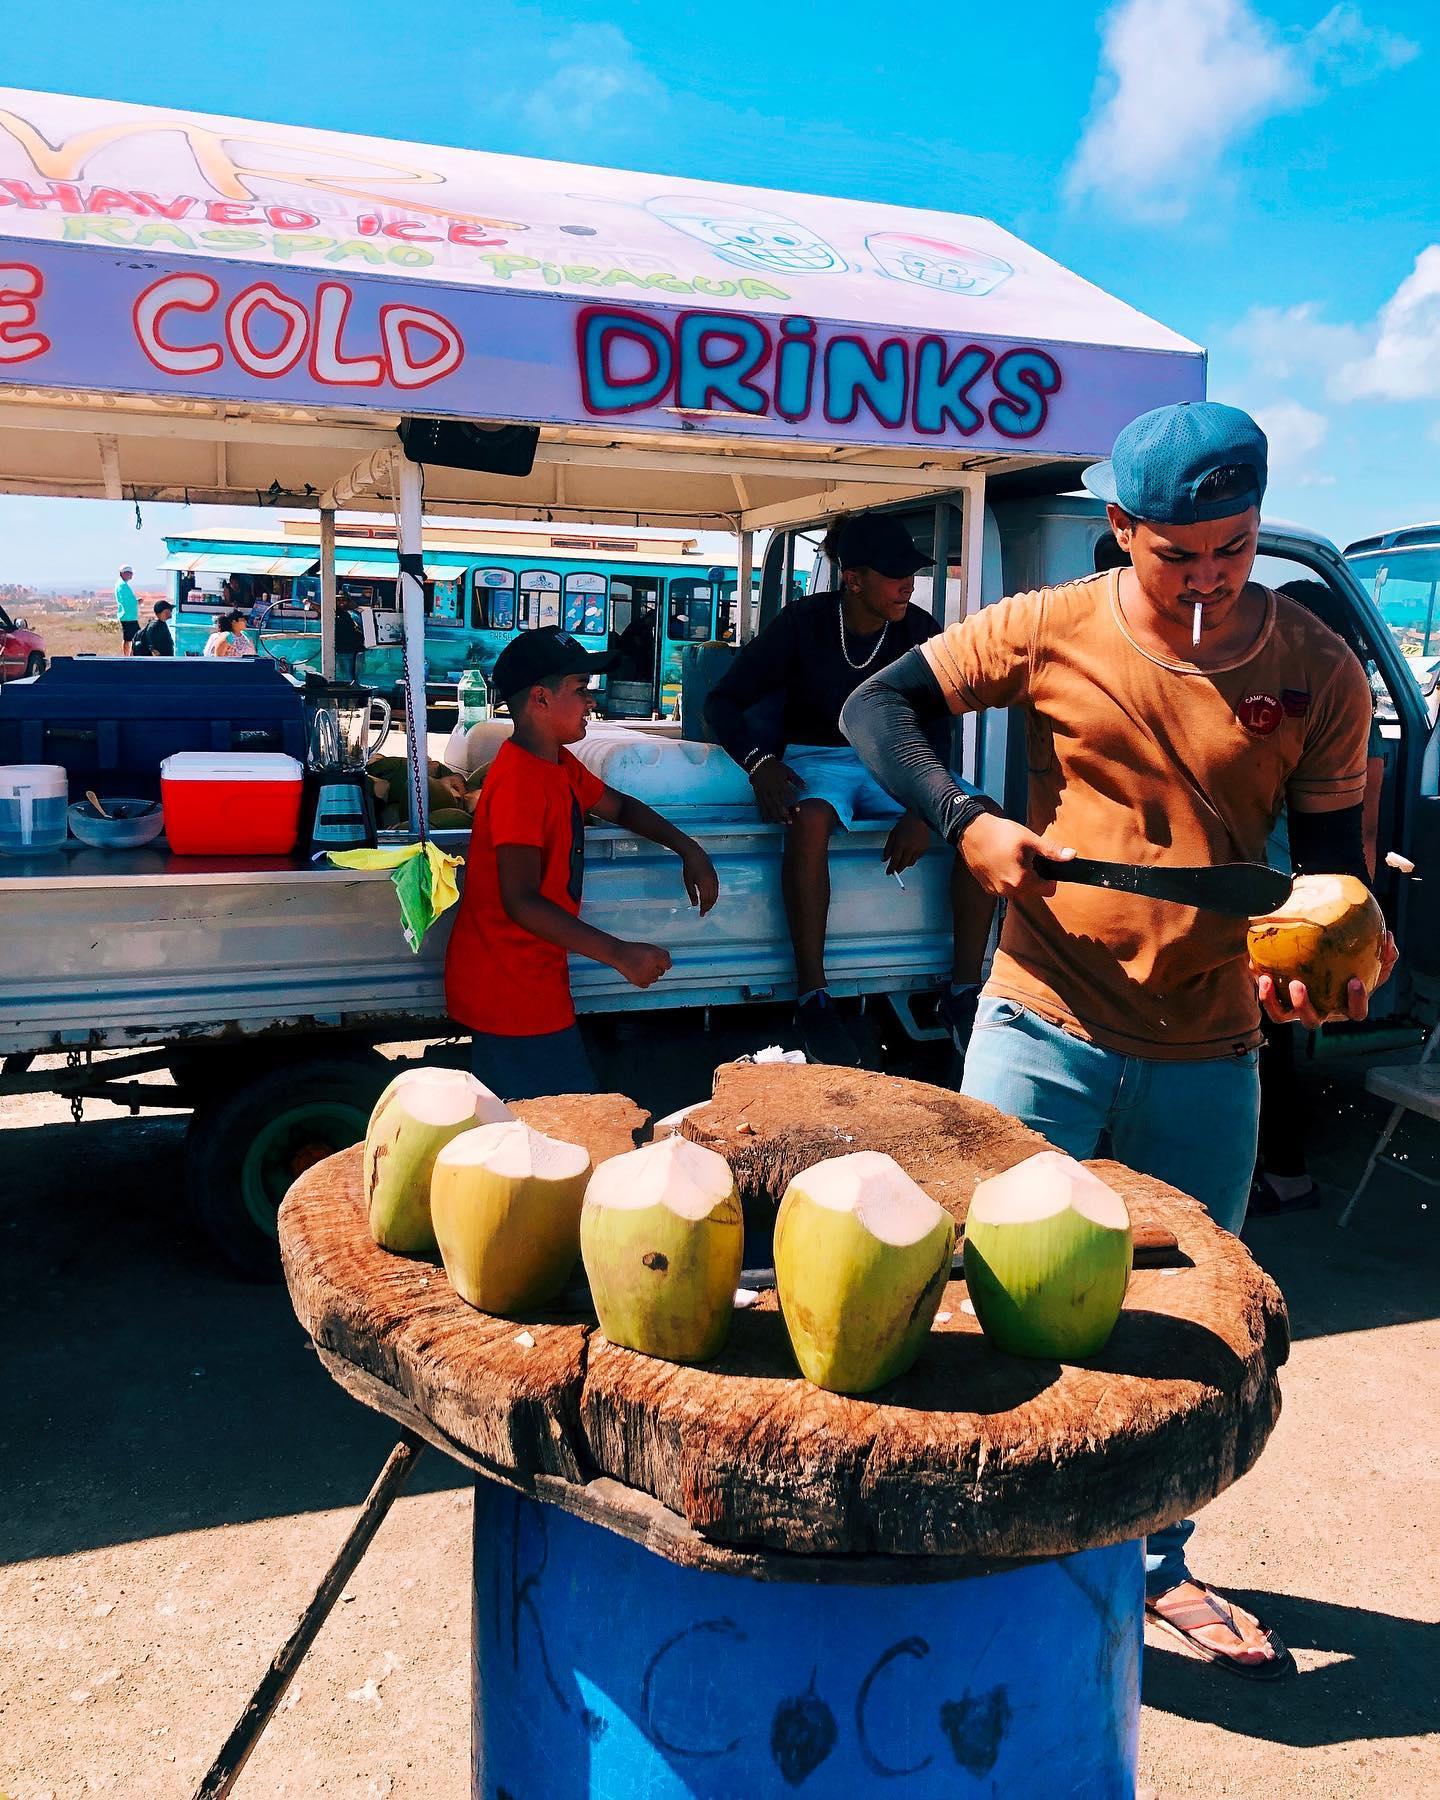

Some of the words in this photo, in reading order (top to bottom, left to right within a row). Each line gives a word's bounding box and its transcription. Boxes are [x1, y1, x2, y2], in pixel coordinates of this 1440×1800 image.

[0, 178, 320, 231] HAVED
[62, 217, 435, 267] RASPAO
[133, 271, 465, 389] COLD
